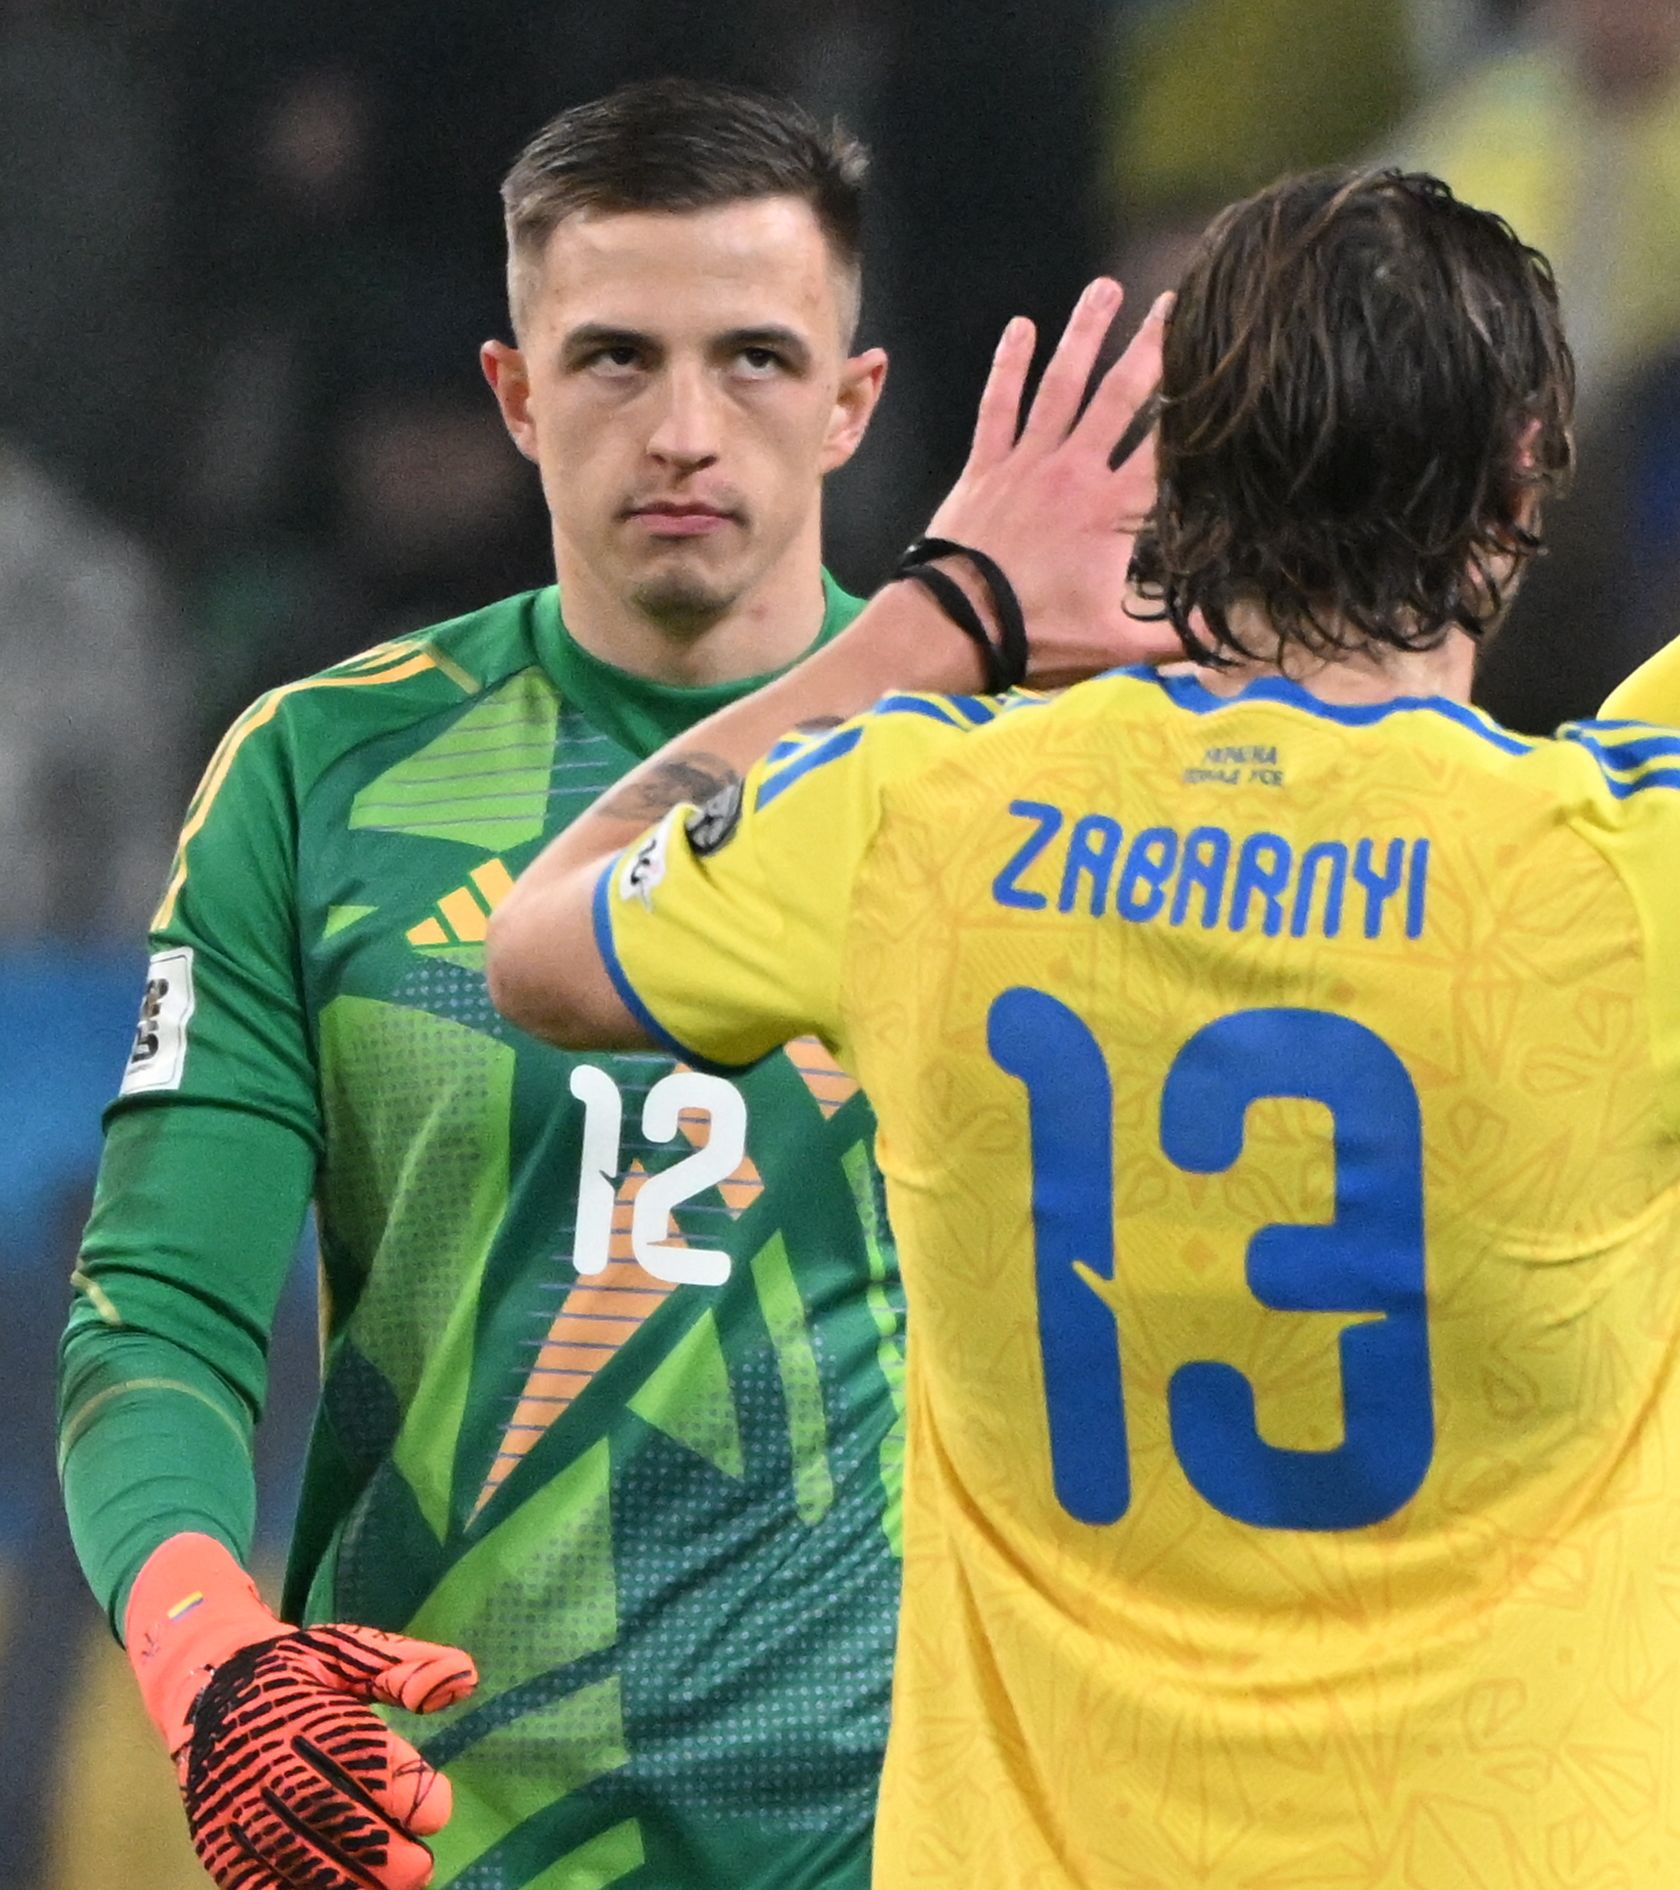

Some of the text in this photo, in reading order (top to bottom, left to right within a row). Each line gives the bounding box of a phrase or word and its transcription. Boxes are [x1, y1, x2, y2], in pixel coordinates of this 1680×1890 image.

[992, 800, 1430, 940] ZABARNYI
[570, 1064, 747, 1286] 12
[986, 986, 1435, 1531] 13
